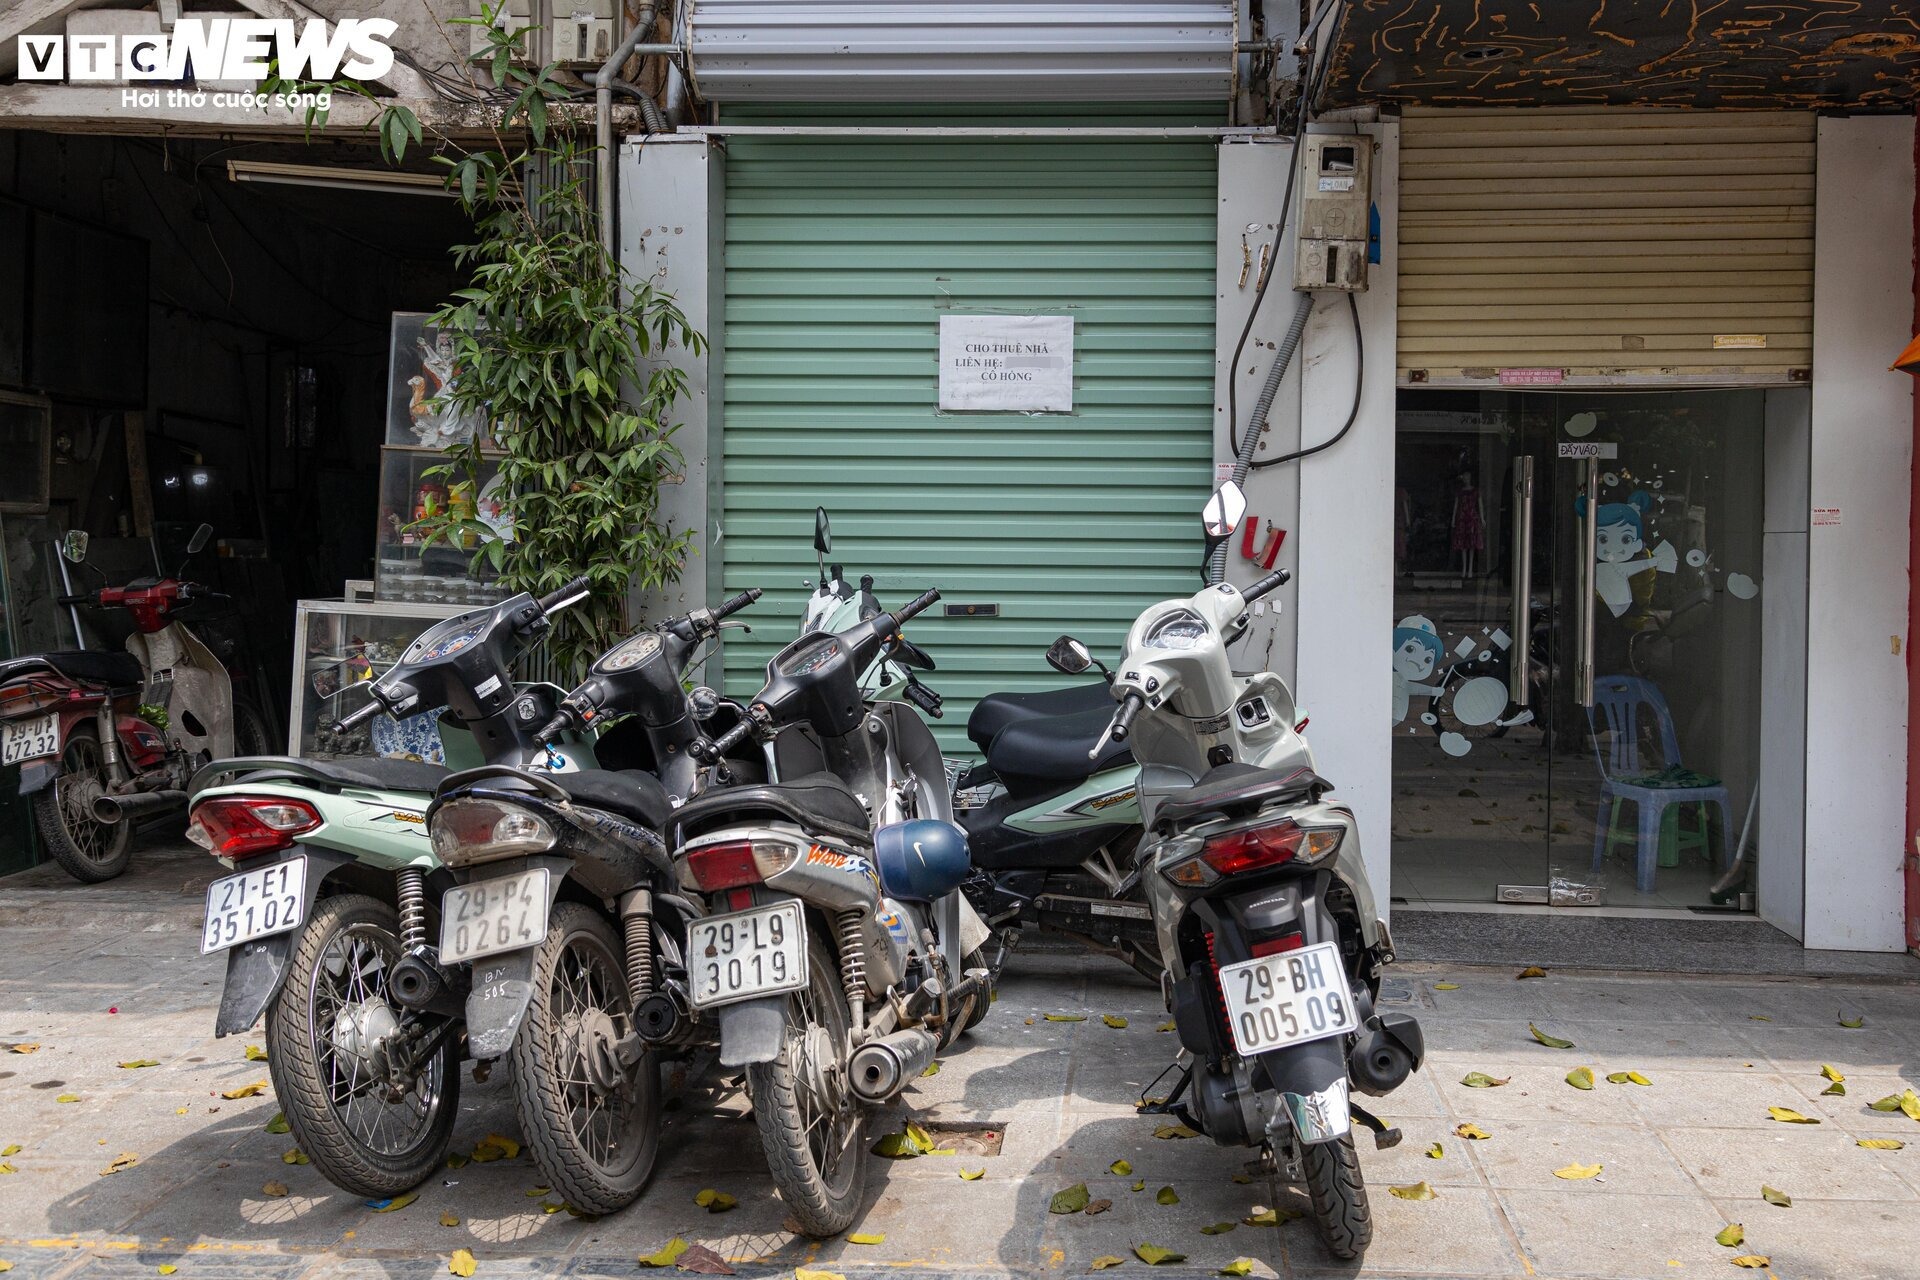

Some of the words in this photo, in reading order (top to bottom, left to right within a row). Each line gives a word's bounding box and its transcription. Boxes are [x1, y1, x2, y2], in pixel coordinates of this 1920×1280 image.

[955, 356, 981, 367] LIÊN
[965, 344, 990, 353] CHO
[991, 343, 1023, 353] THUÊ
[981, 370, 997, 381] CÔ
[5, 734, 56, 762] 472.32
[221, 865, 288, 912] 21-E1
[456, 877, 532, 922] 29-P4
[208, 895, 296, 947] 351.02
[455, 911, 531, 955] 0264
[704, 914, 784, 958] 29-L9
[707, 950, 786, 994] 3019
[1239, 953, 1325, 1005] 29-BH
[1240, 991, 1346, 1047] 005.09
